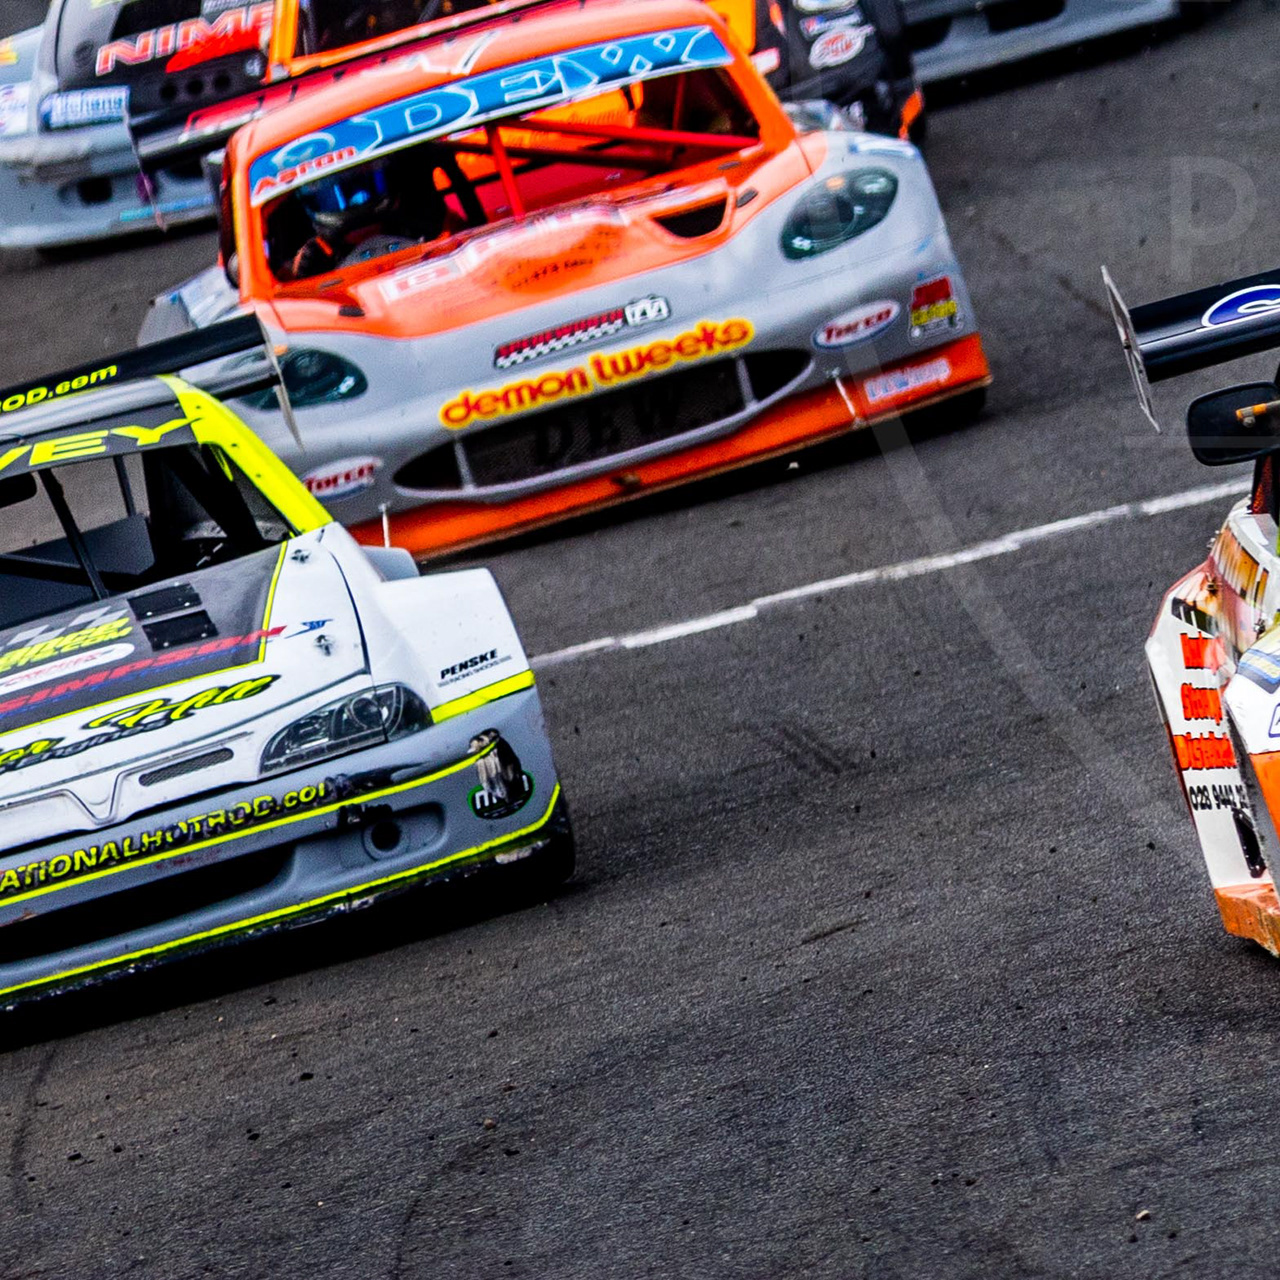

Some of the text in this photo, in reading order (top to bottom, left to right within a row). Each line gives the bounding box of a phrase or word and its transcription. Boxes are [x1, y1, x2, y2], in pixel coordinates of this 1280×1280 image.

[0, 364, 118, 414] OD.com
[438, 317, 756, 429] demon tweeks
[440, 648, 499, 681] PENSKE
[0, 780, 338, 893] ATIONALHOTROD.co
